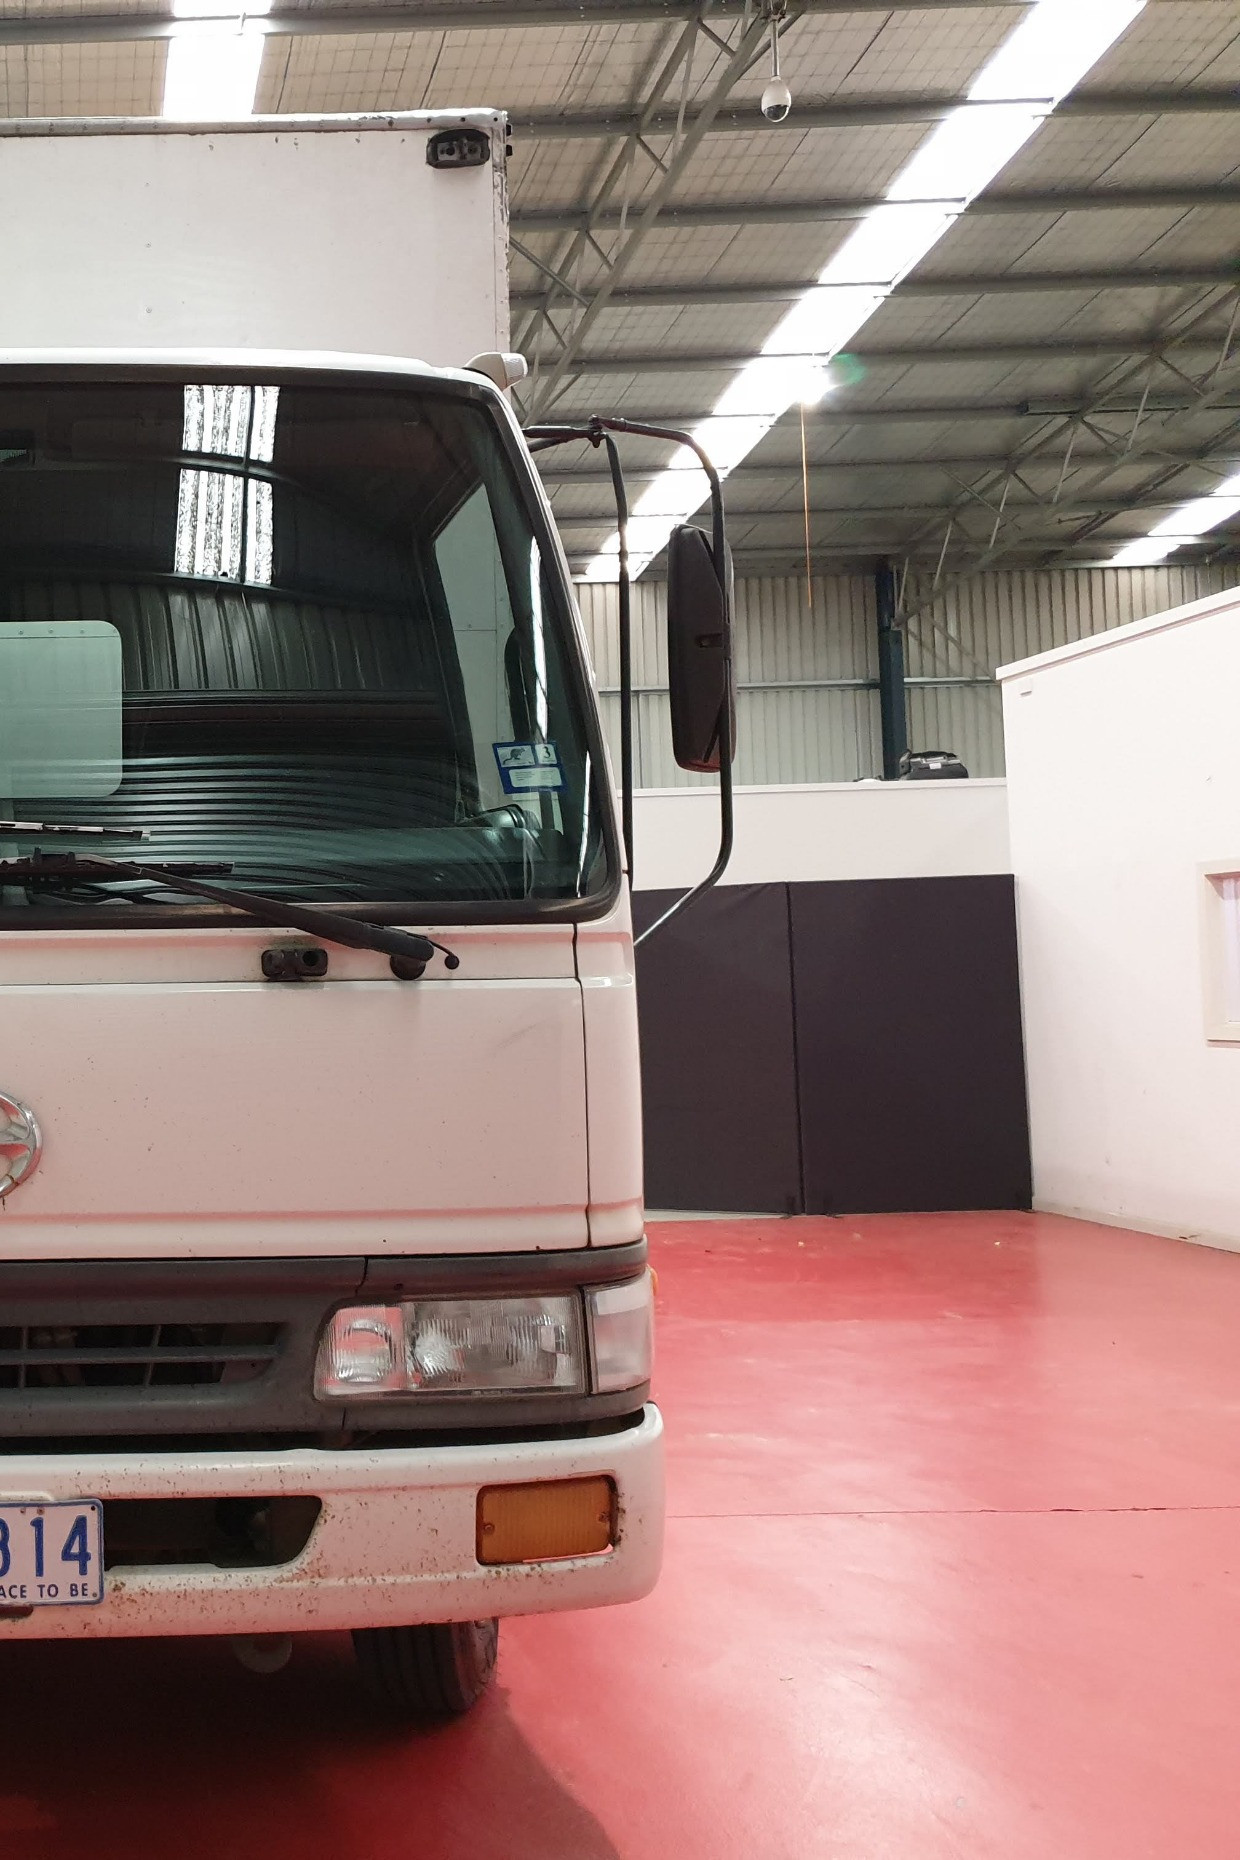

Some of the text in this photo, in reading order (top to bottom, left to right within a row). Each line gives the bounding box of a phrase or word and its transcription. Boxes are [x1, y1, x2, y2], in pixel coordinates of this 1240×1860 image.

[543, 745, 551, 758] 3
[36, 1583, 59, 1599] TO
[69, 1582, 88, 1598] BE
